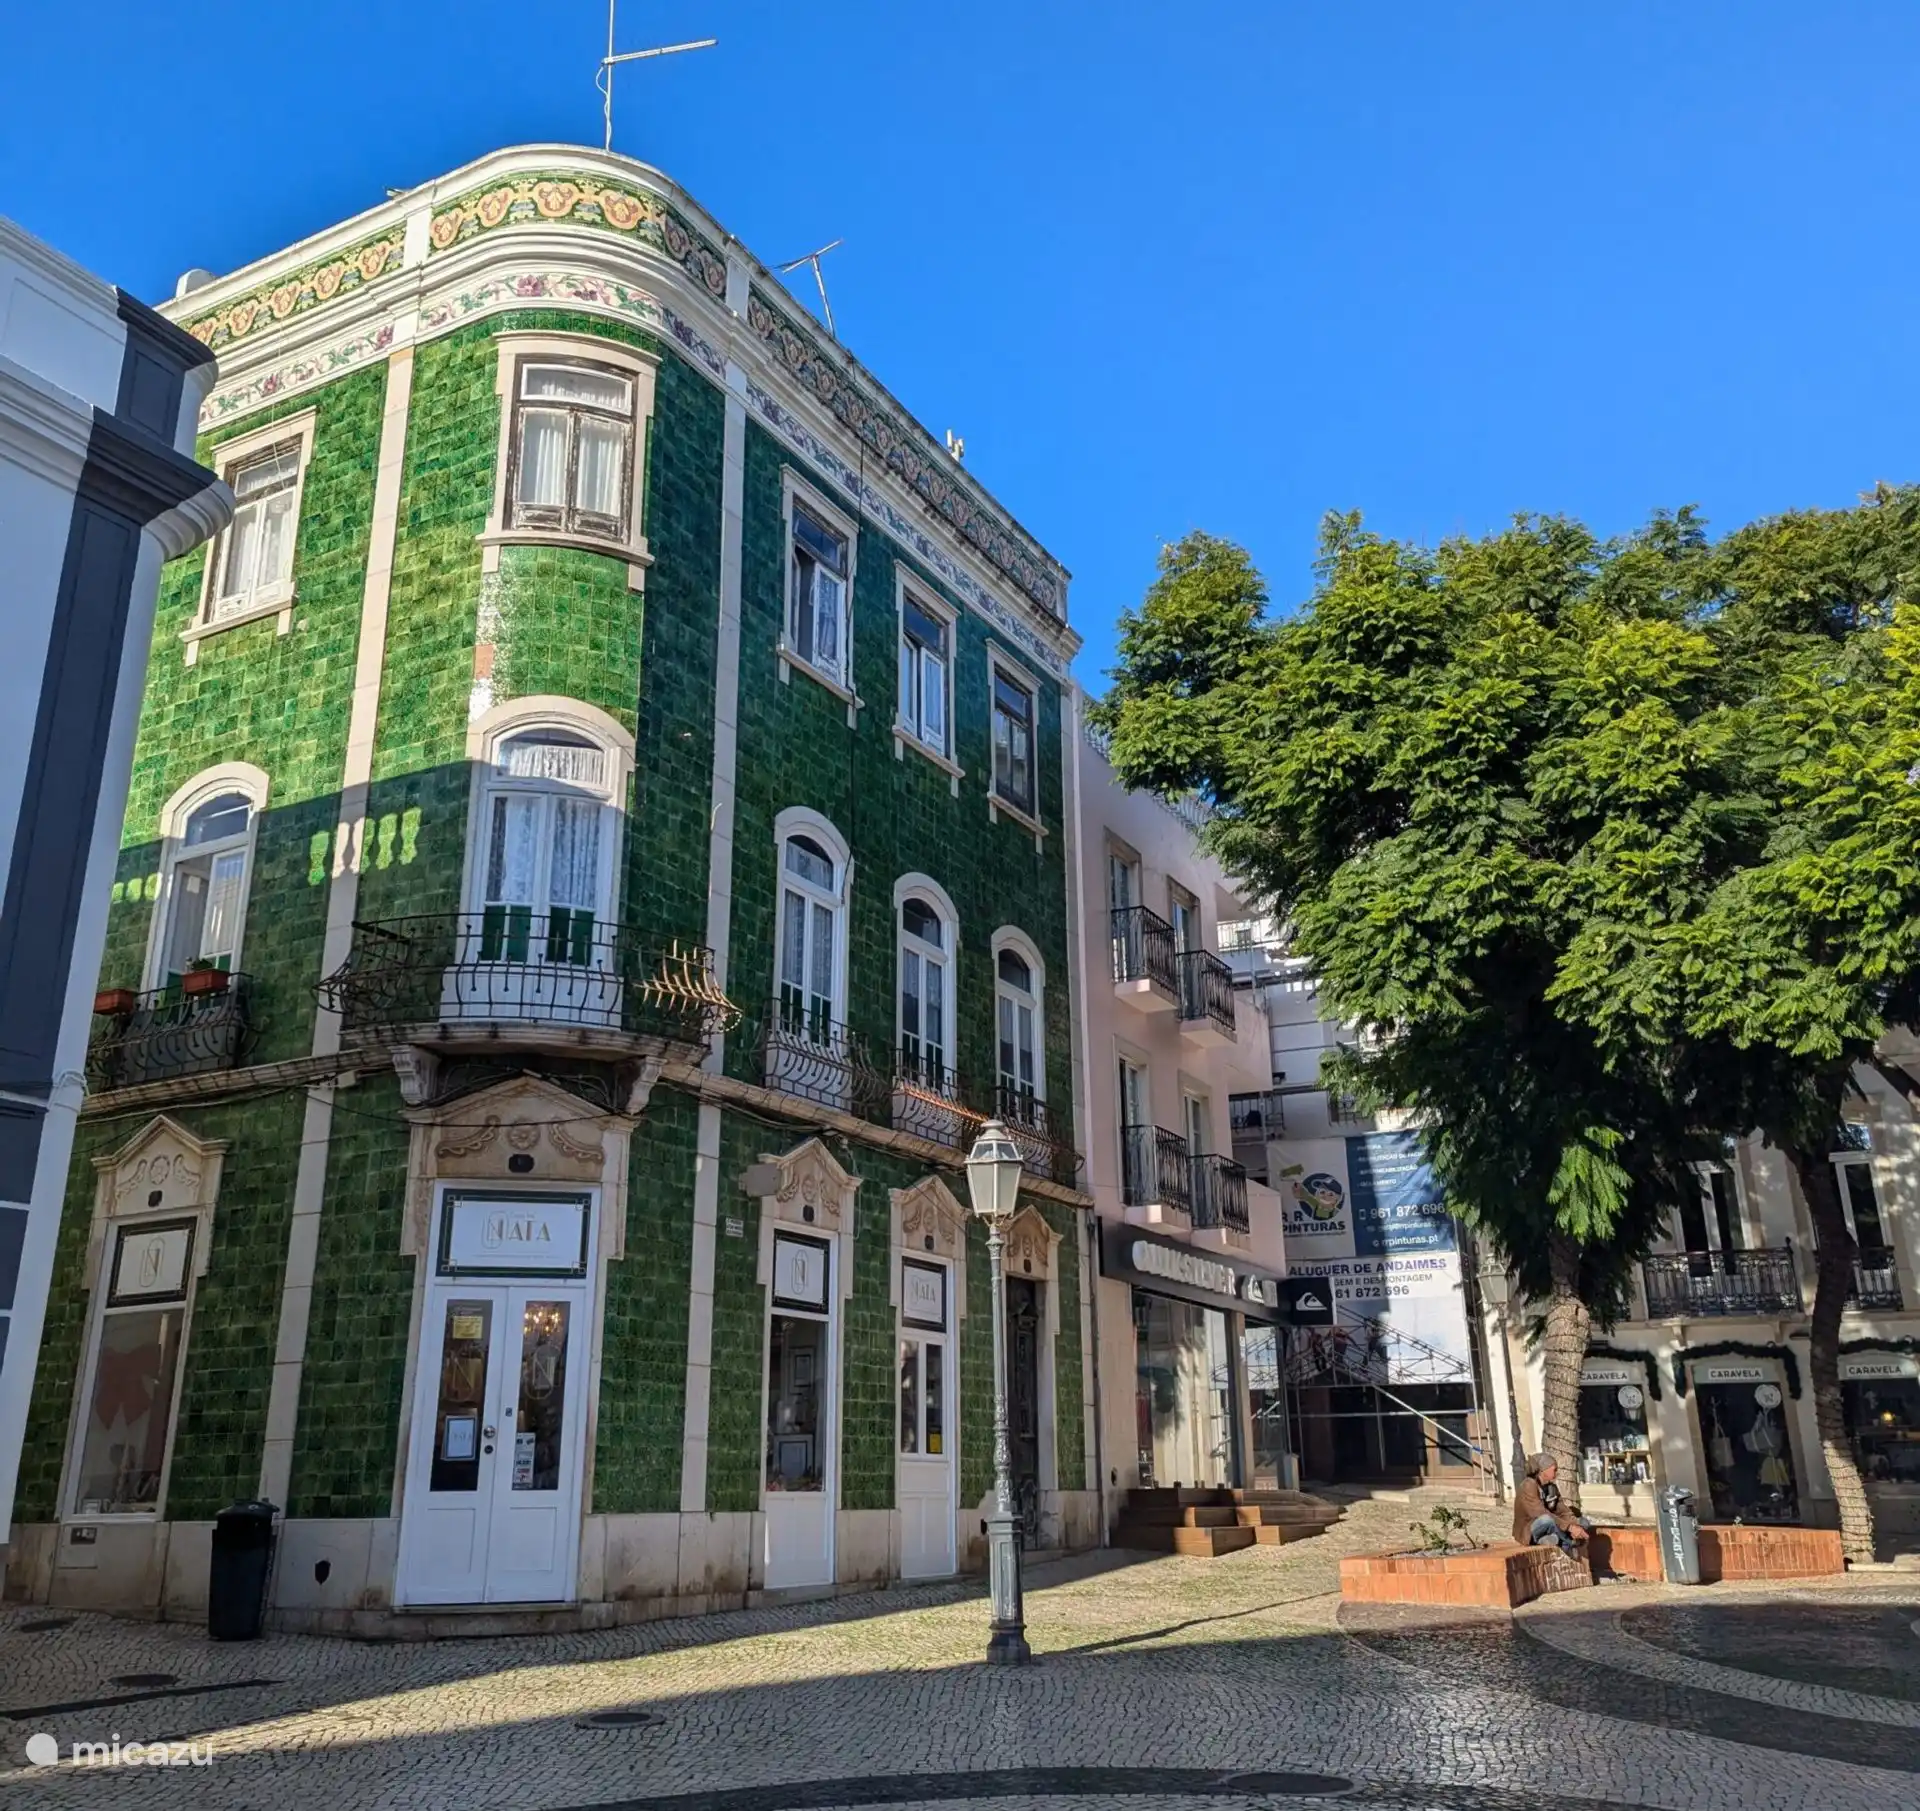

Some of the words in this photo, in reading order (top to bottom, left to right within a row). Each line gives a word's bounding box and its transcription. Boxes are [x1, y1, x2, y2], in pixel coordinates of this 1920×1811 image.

[1294, 1211, 1304, 1222] R
[1370, 1208, 1391, 1218] 961
[1396, 1205, 1420, 1217] 872
[1422, 1203, 1445, 1214] 696
[486, 1219, 551, 1241] NATA
[1282, 1221, 1346, 1233] PINTURAS
[1289, 1264, 1350, 1276] ALUGUER
[1354, 1263, 1372, 1274] DE
[1376, 1258, 1447, 1273] ANDAIMES
[1355, 1277, 1360, 1285] E
[1363, 1273, 1433, 1285] DESMONTAGEM
[1335, 1288, 1350, 1298] 61
[1355, 1287, 1380, 1297] 872
[1385, 1285, 1409, 1296] 696
[1580, 1372, 1628, 1381] CARAVELA
[1710, 1369, 1762, 1379] CARAVELA
[1848, 1366, 1902, 1375] CARAVELA
